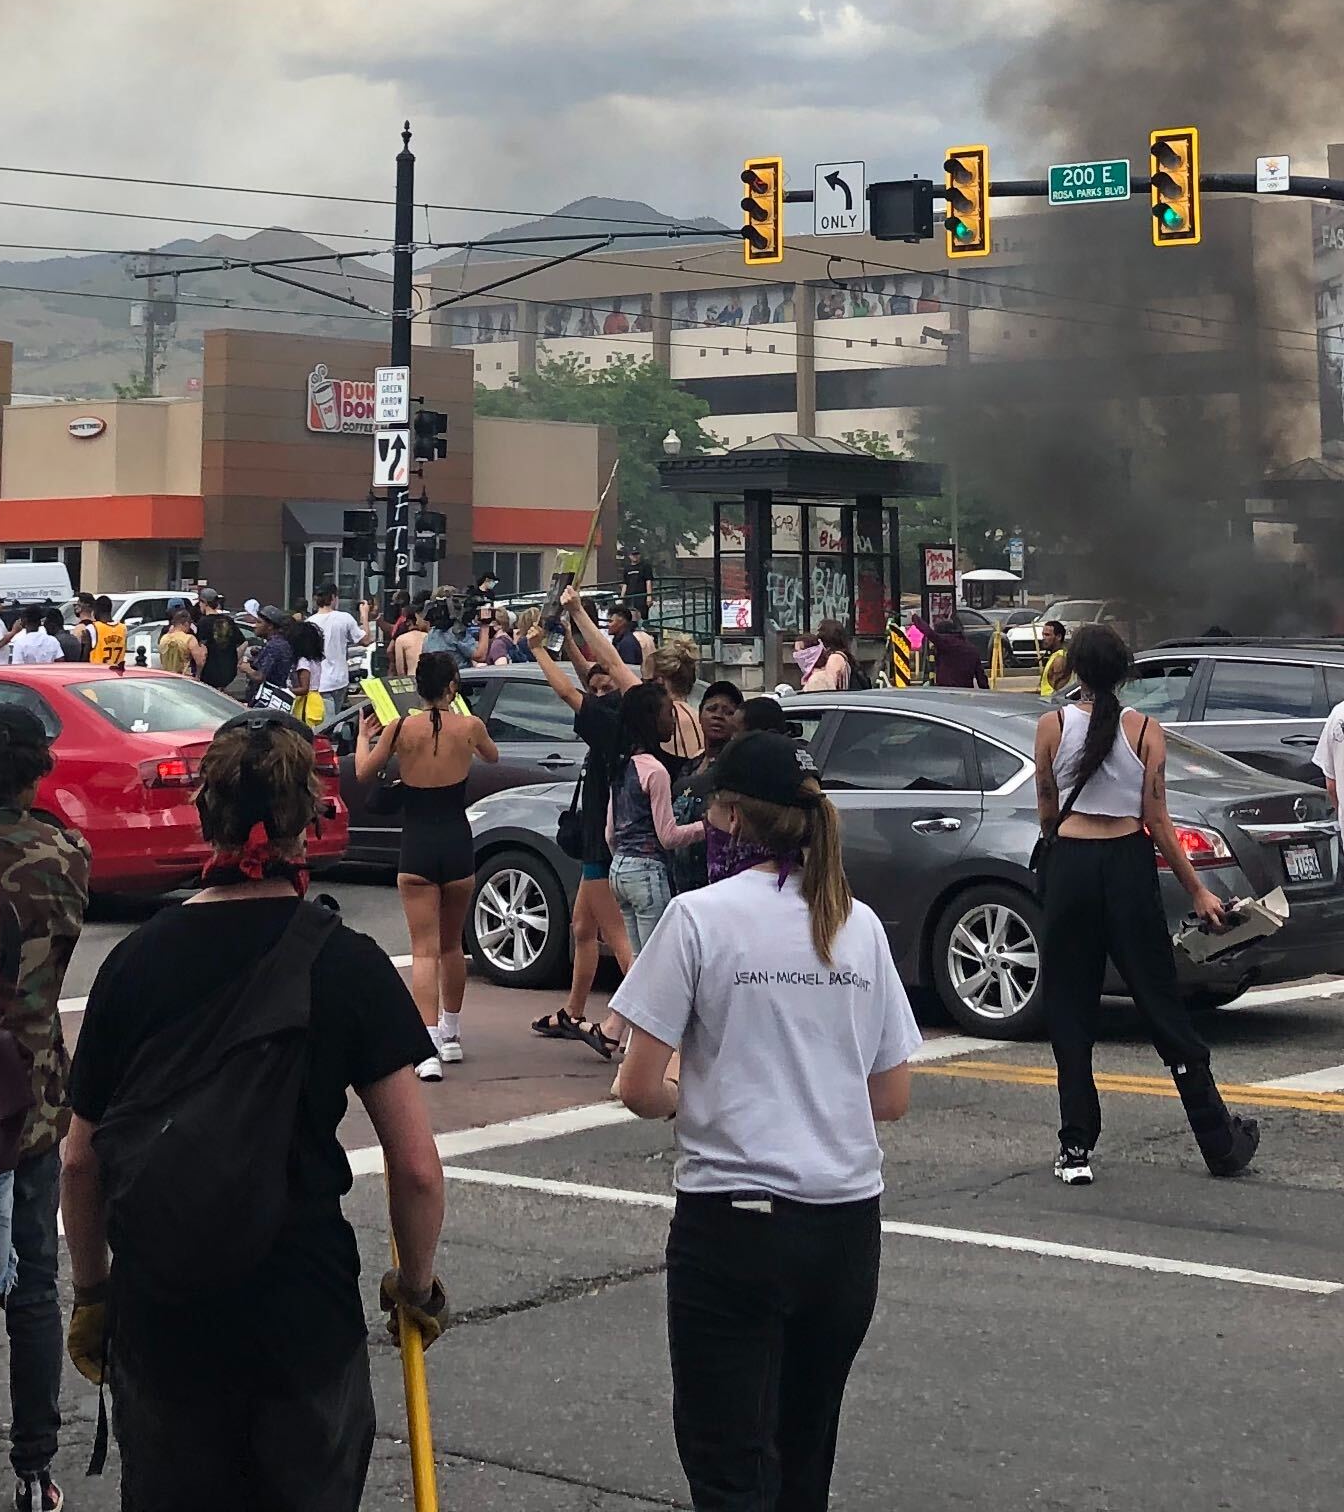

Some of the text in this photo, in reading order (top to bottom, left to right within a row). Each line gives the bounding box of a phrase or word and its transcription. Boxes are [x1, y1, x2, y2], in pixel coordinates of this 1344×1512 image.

[1063, 168, 1095, 186] 200
[1052, 190, 1074, 200] ROSA
[1077, 187, 1102, 198] PARKS
[821, 214, 858, 229] ONLY
[379, 372, 405, 382] LEFT ON
[381, 384, 402, 393] GREEN
[381, 396, 402, 406] ARROW
[383, 408, 399, 418] ONLY
[342, 421, 373, 432] COFFEE
[17, 590, 38, 598] Deliver
[103, 646, 124, 664] 27
[734, 971, 825, 986] JEAN-MICHEL
